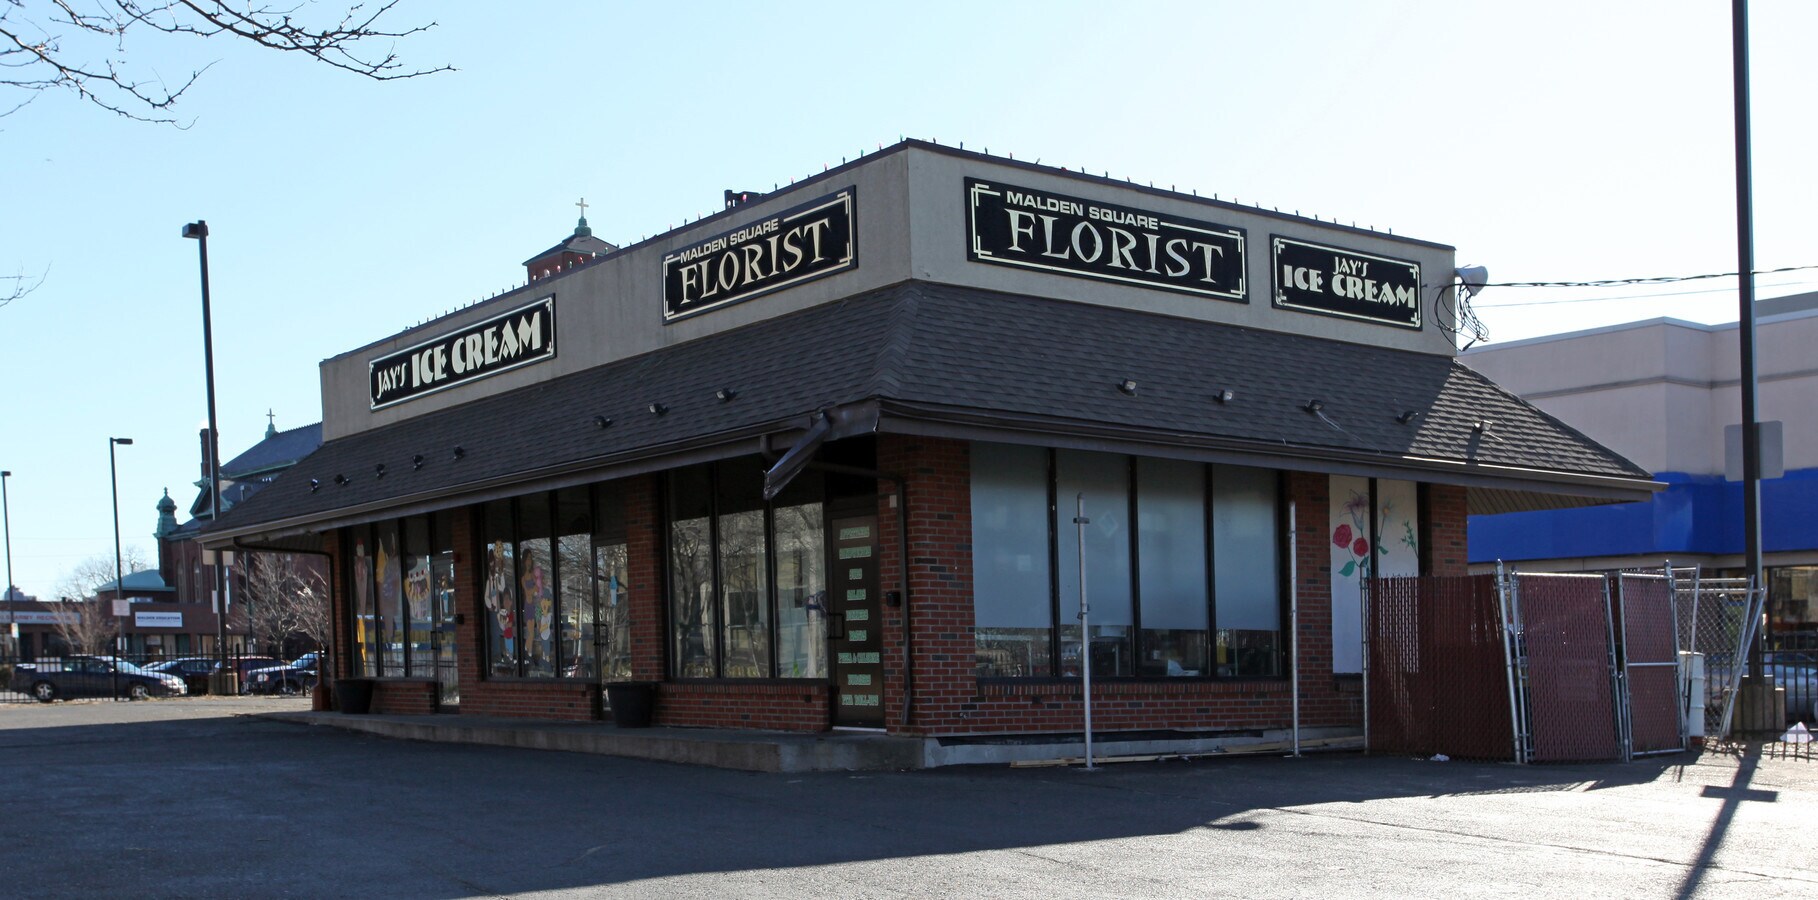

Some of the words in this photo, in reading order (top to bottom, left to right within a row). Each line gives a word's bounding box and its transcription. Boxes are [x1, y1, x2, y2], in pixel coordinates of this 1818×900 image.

[1006, 190, 1084, 217] MALDEN
[1088, 206, 1159, 231] SQUARE
[678, 217, 830, 305] FLORIST
[679, 235, 728, 263] MALDEN
[729, 218, 780, 245] SQUARE
[1004, 208, 1224, 284] FLORIST
[1283, 264, 1324, 293] ICE
[1331, 273, 1416, 309] CREAM
[1332, 256, 1369, 278] JAY'S
[377, 363, 407, 399] JAY'S
[411, 344, 448, 388] ICE
[451, 312, 542, 374] CREAM
